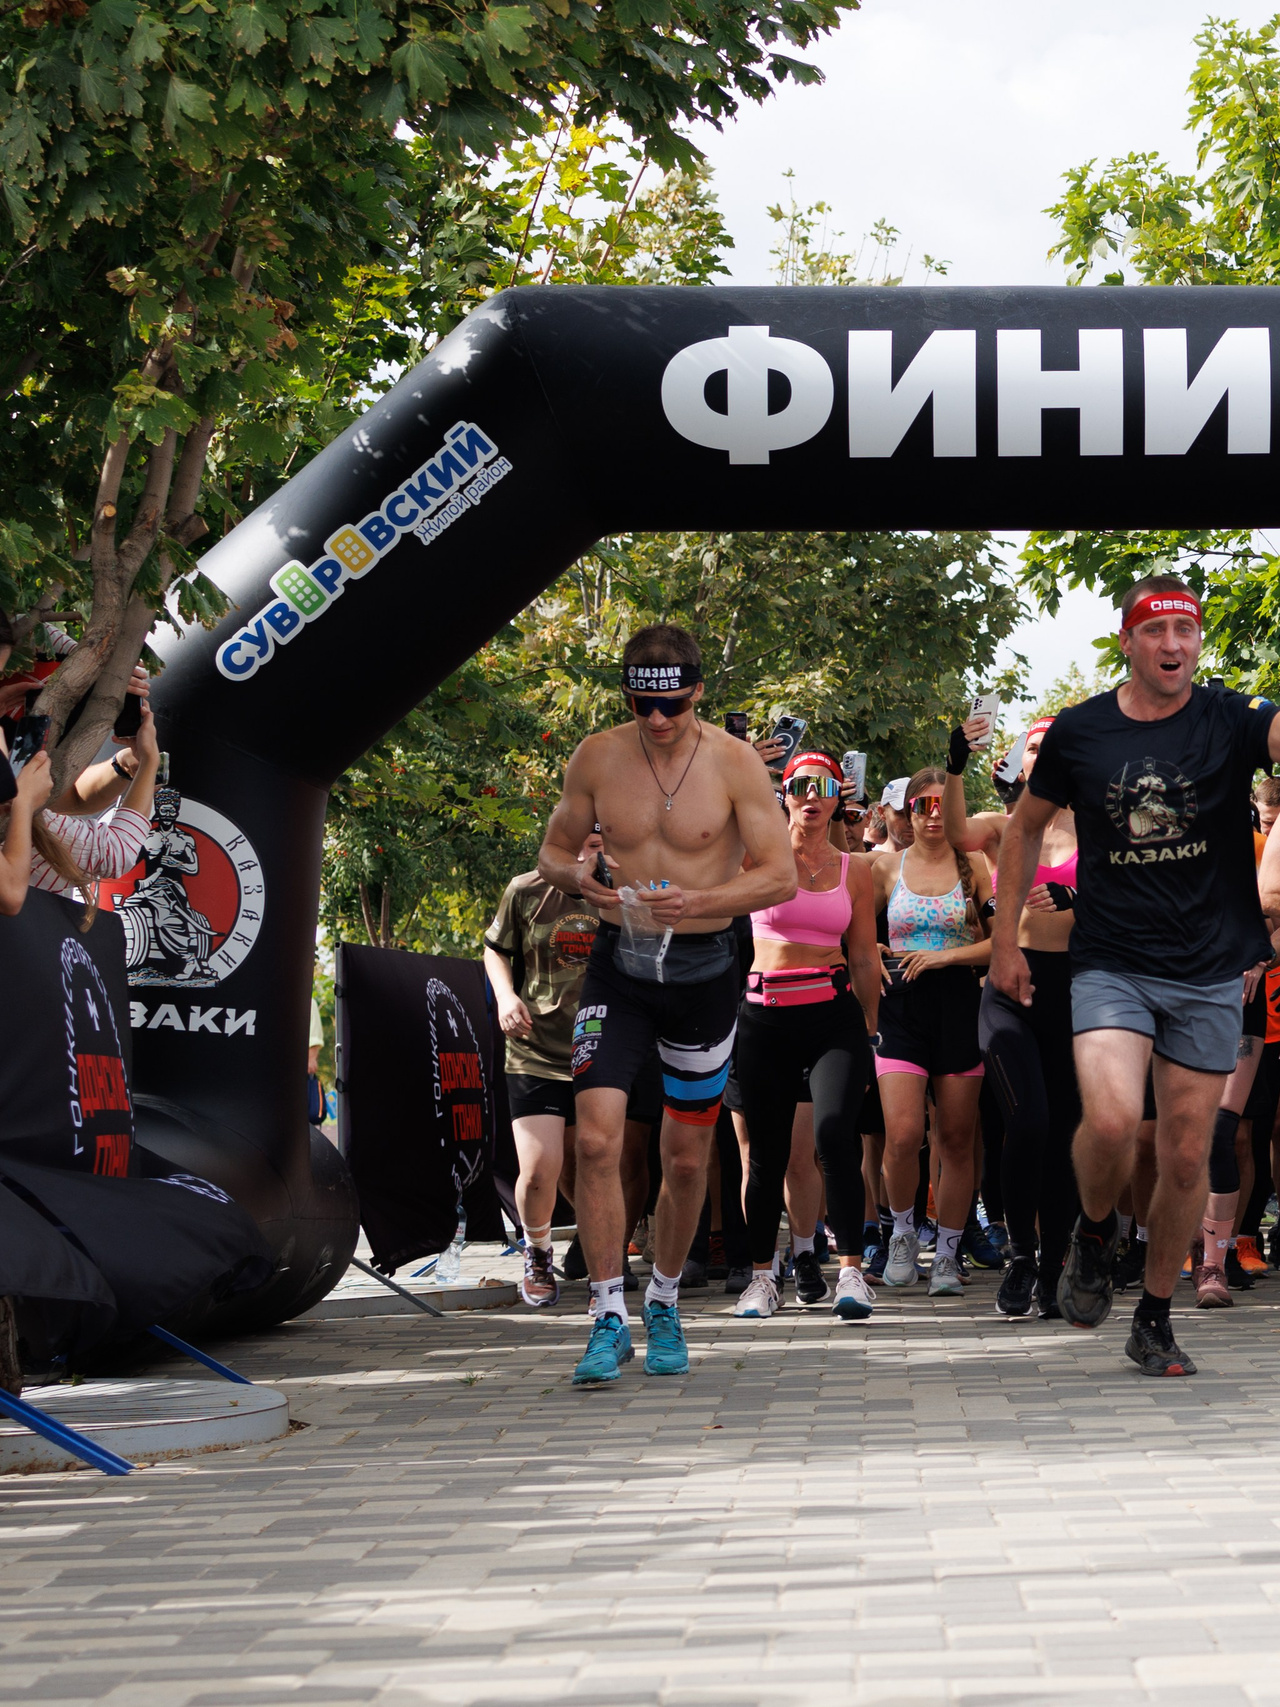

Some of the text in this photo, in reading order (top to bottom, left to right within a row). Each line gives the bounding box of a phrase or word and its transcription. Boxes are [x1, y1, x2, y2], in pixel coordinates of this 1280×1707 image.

[416, 458, 511, 544] Жилой район
[629, 677, 680, 690] 00485
[637, 665, 682, 679] КАЗАКИ
[1109, 840, 1207, 865] КАЗАКИ
[218, 834, 263, 970] КАЗАКИ
[565, 913, 601, 927] ПРЕПЯТС
[129, 1001, 257, 1037] ЗАКИ
